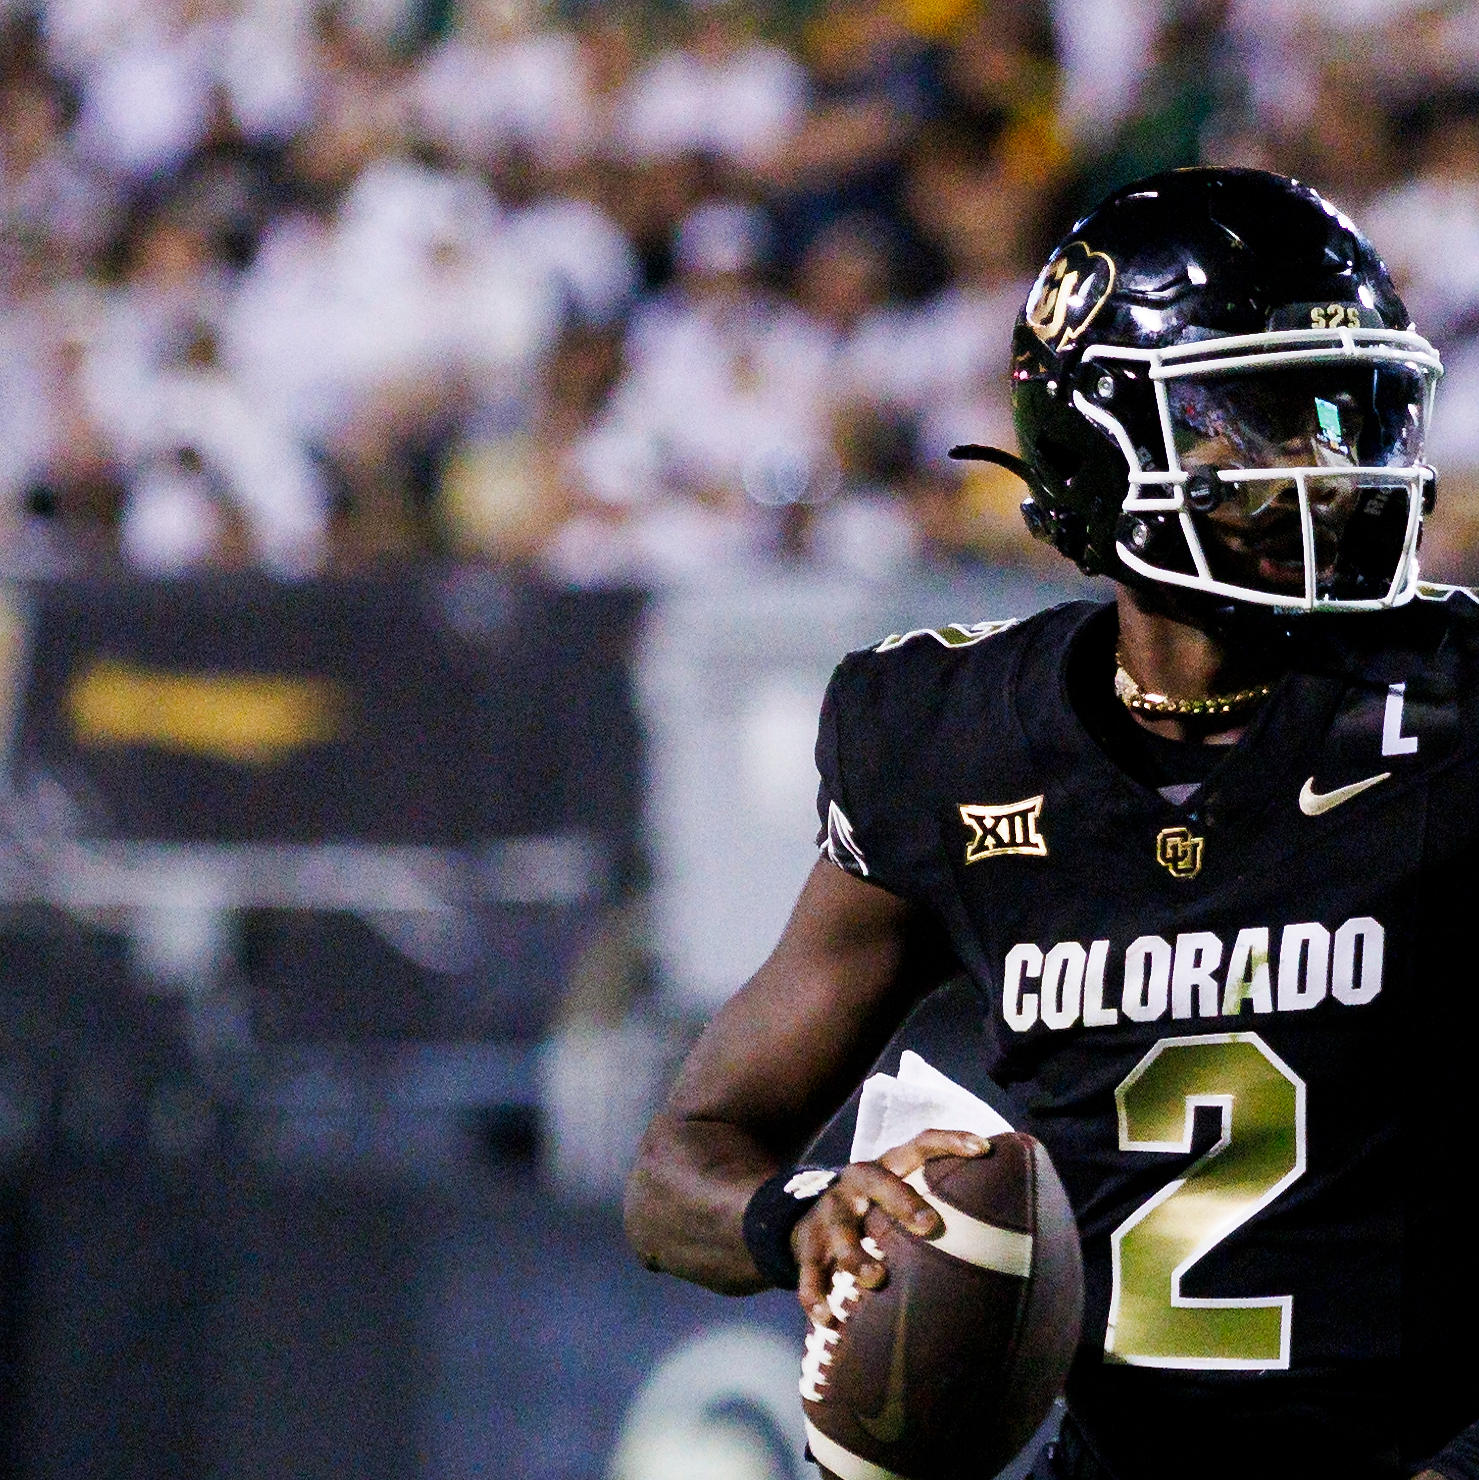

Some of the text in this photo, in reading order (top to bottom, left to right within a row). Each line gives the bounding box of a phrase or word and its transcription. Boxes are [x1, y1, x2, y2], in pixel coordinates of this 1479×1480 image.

[1381, 682, 1419, 757] L
[1002, 915, 1385, 1033] COLORADO
[1103, 1031, 1307, 1371] 2
